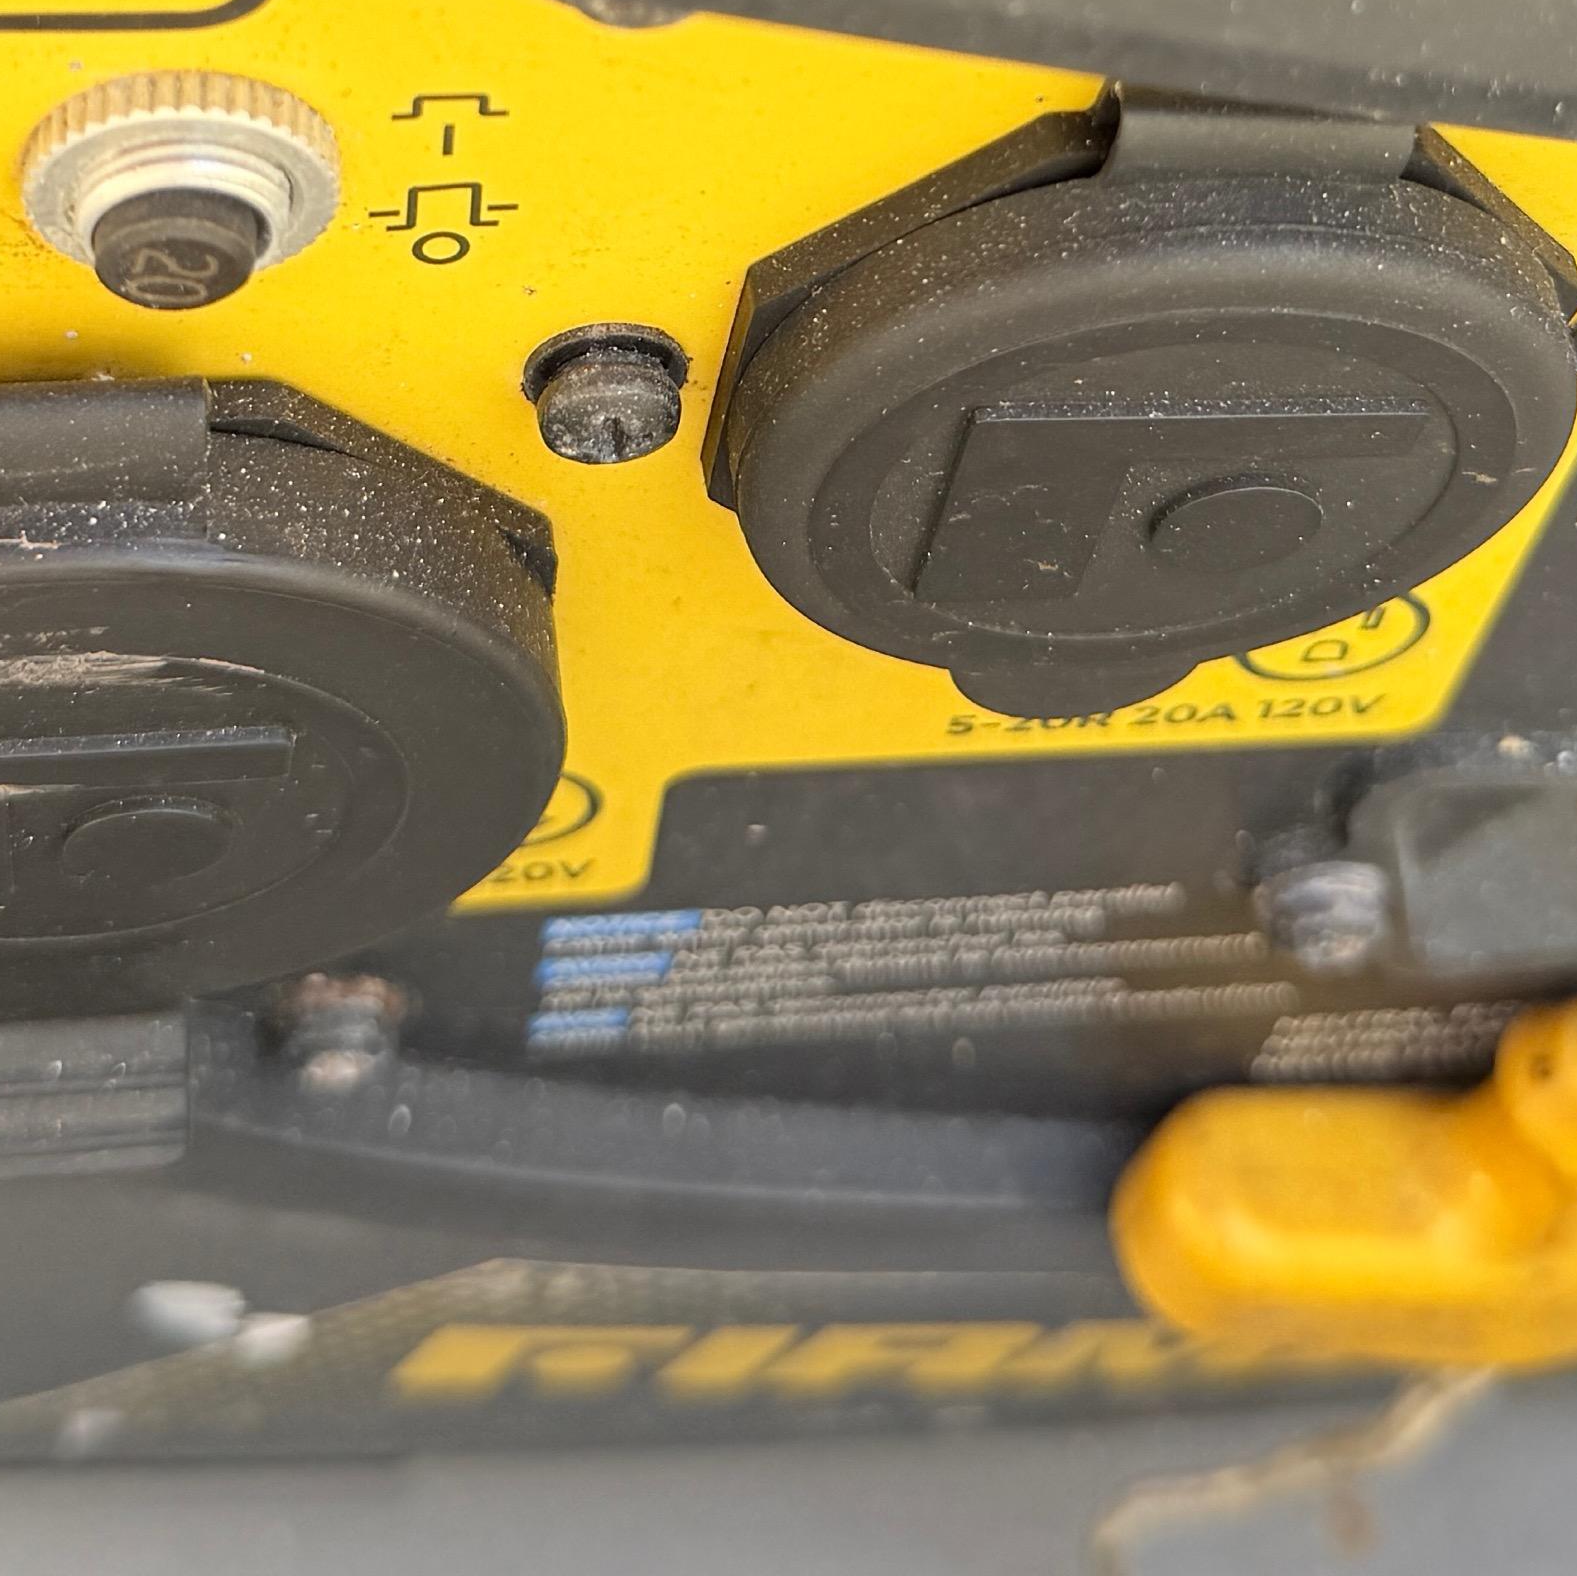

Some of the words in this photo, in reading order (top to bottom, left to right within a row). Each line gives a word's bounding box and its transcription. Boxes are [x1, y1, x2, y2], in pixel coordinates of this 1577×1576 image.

[131, 247, 219, 304] 20
[1127, 701, 1239, 727] 20A
[1258, 693, 1387, 721] 120V
